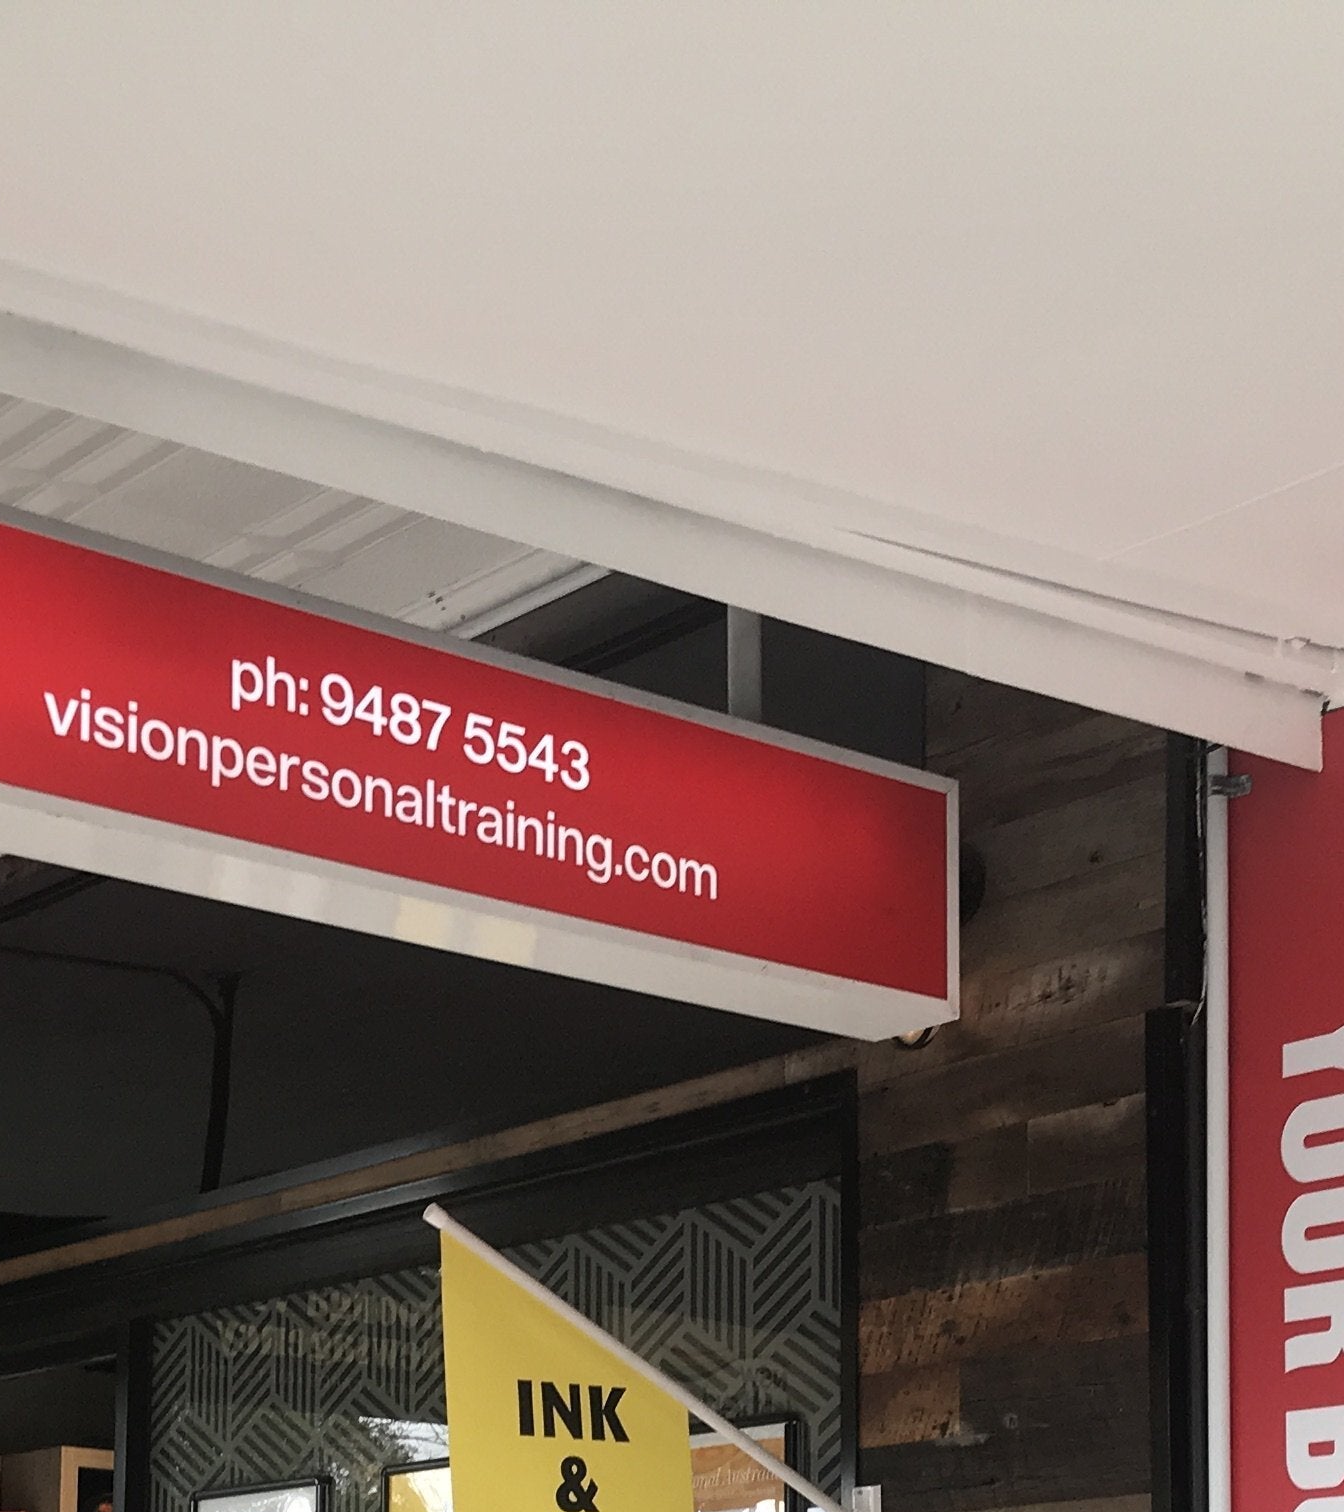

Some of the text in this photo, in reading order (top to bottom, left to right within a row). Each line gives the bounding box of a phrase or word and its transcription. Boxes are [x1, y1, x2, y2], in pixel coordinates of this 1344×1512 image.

[230, 656, 591, 791] ph: 9487 5543
[43, 687, 718, 901] visionpersonaltraining.com
[516, 1379, 630, 1443] INK
